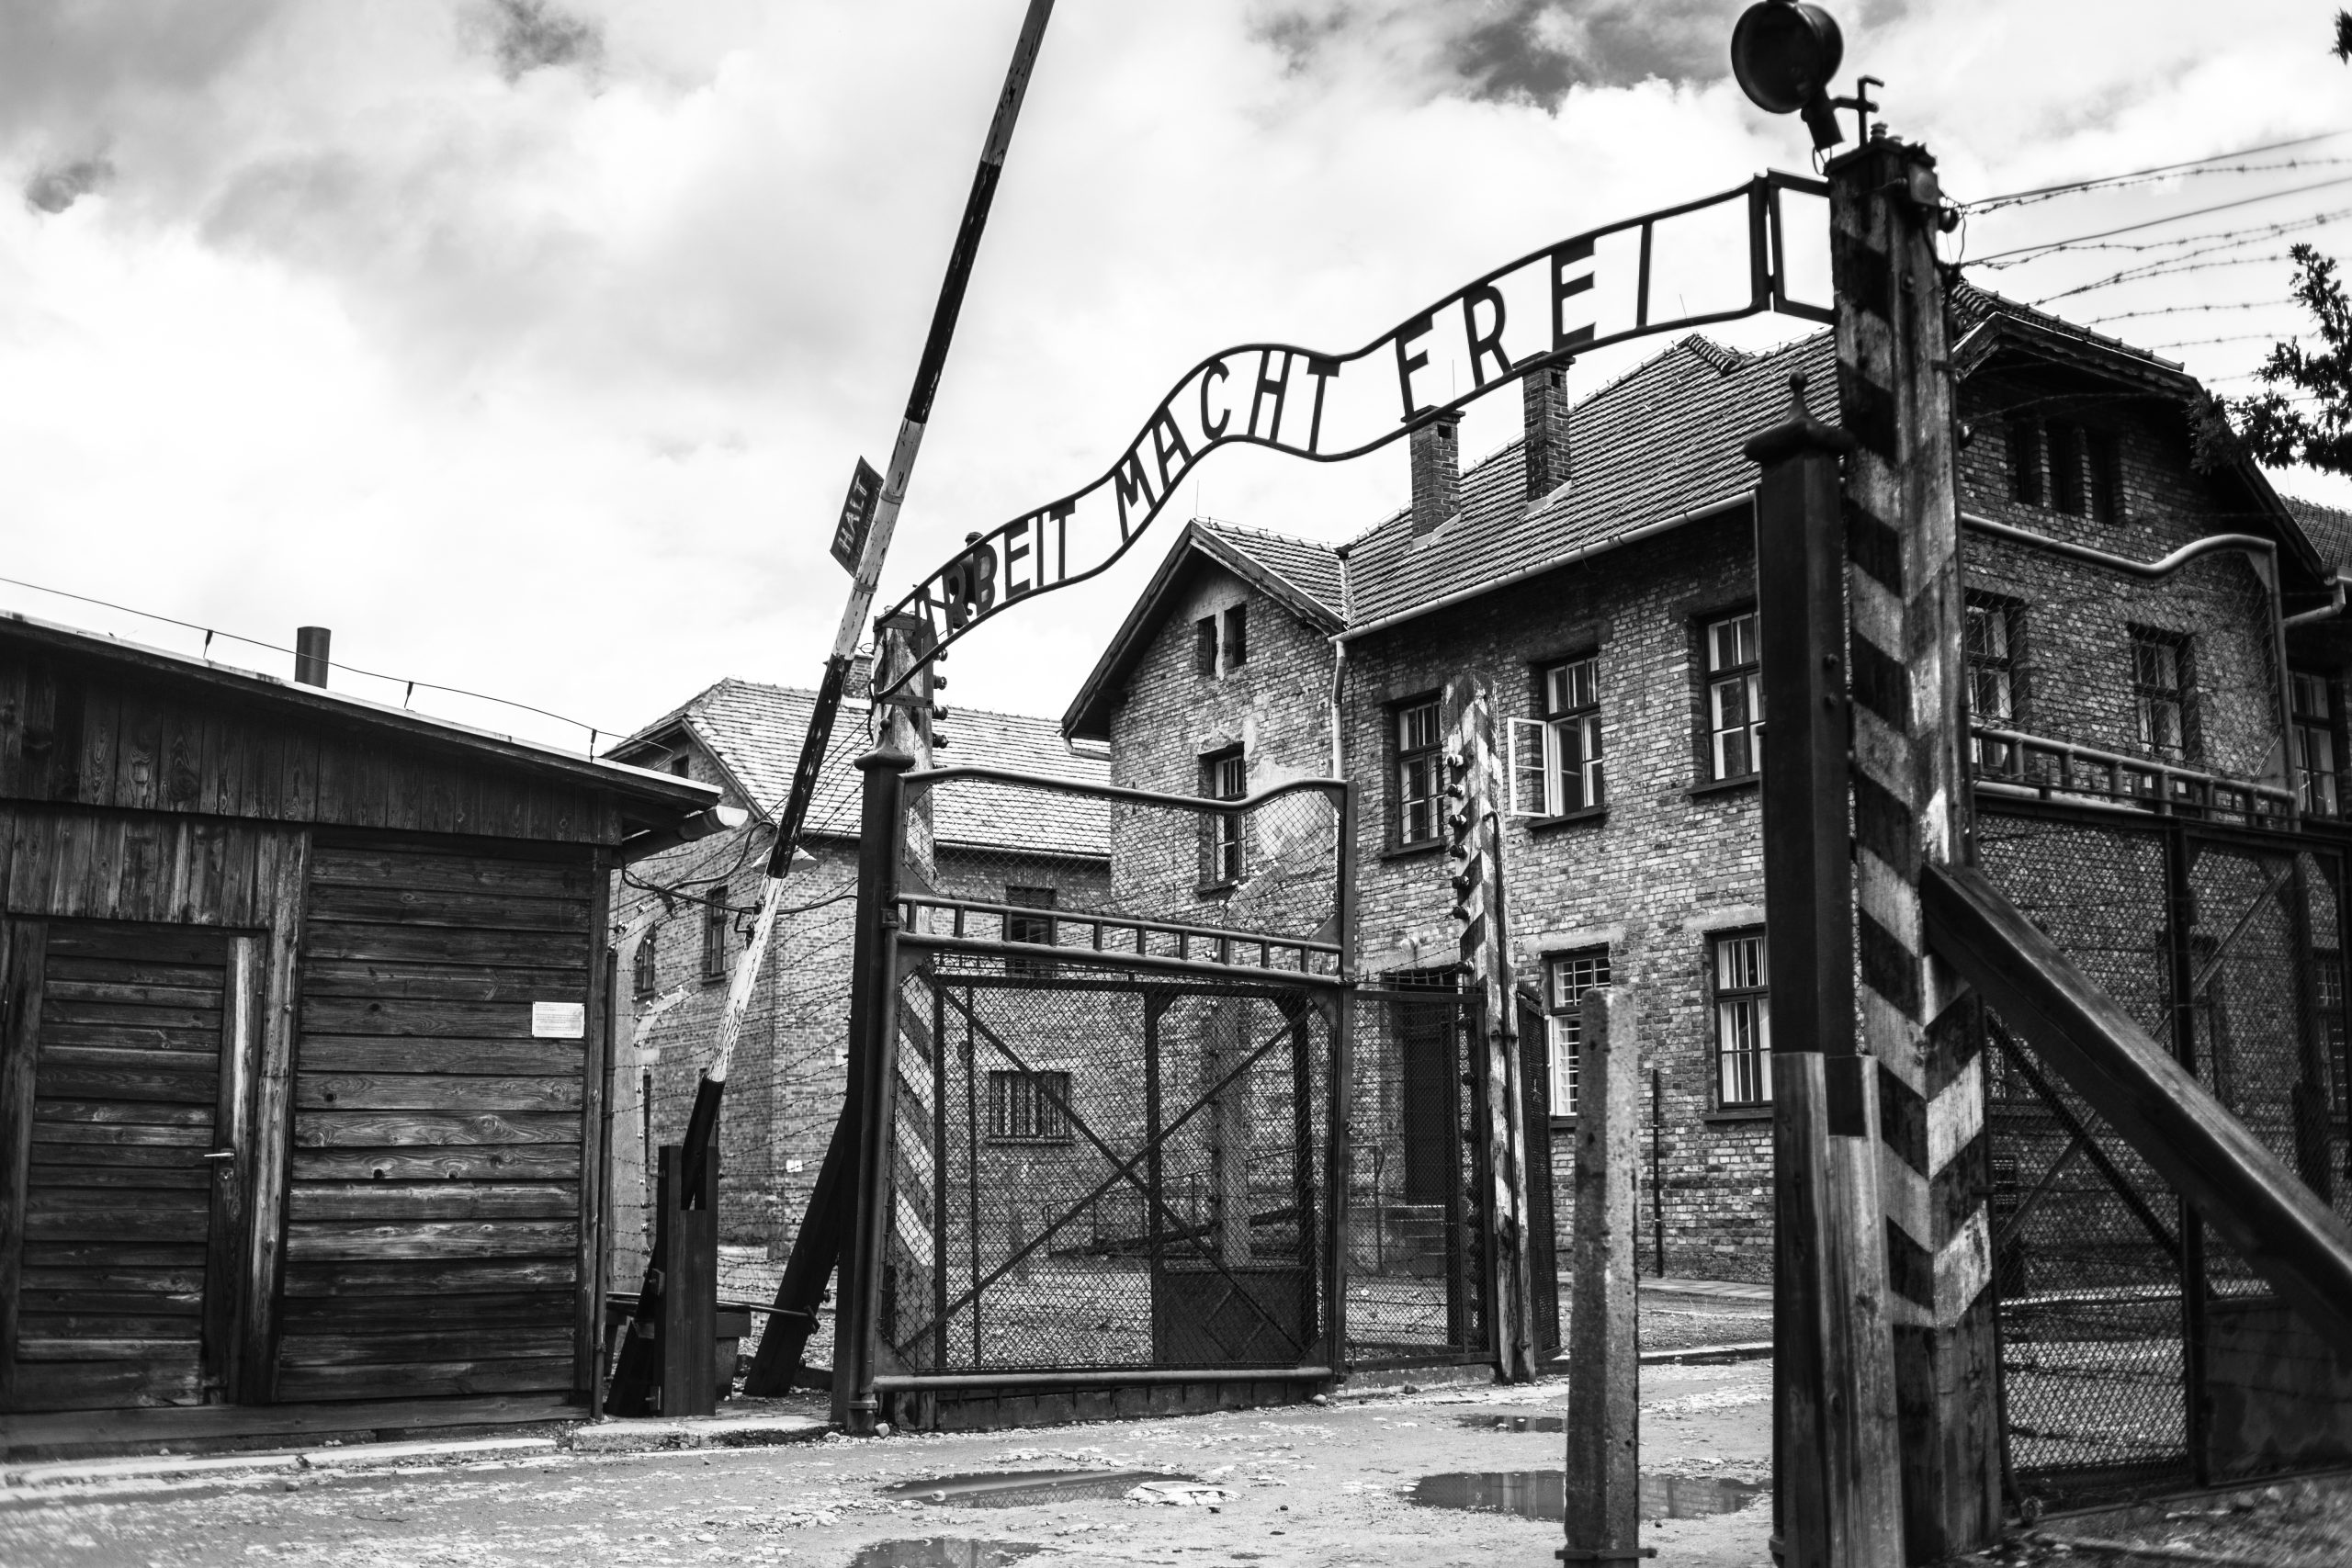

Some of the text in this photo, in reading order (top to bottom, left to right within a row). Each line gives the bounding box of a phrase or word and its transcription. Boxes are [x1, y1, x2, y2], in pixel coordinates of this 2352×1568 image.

[837, 474, 867, 553] HALT
[915, 499, 1075, 657] ARBEIT
[1114, 349, 1340, 544] MACHT
[1396, 221, 1653, 420] FREI
